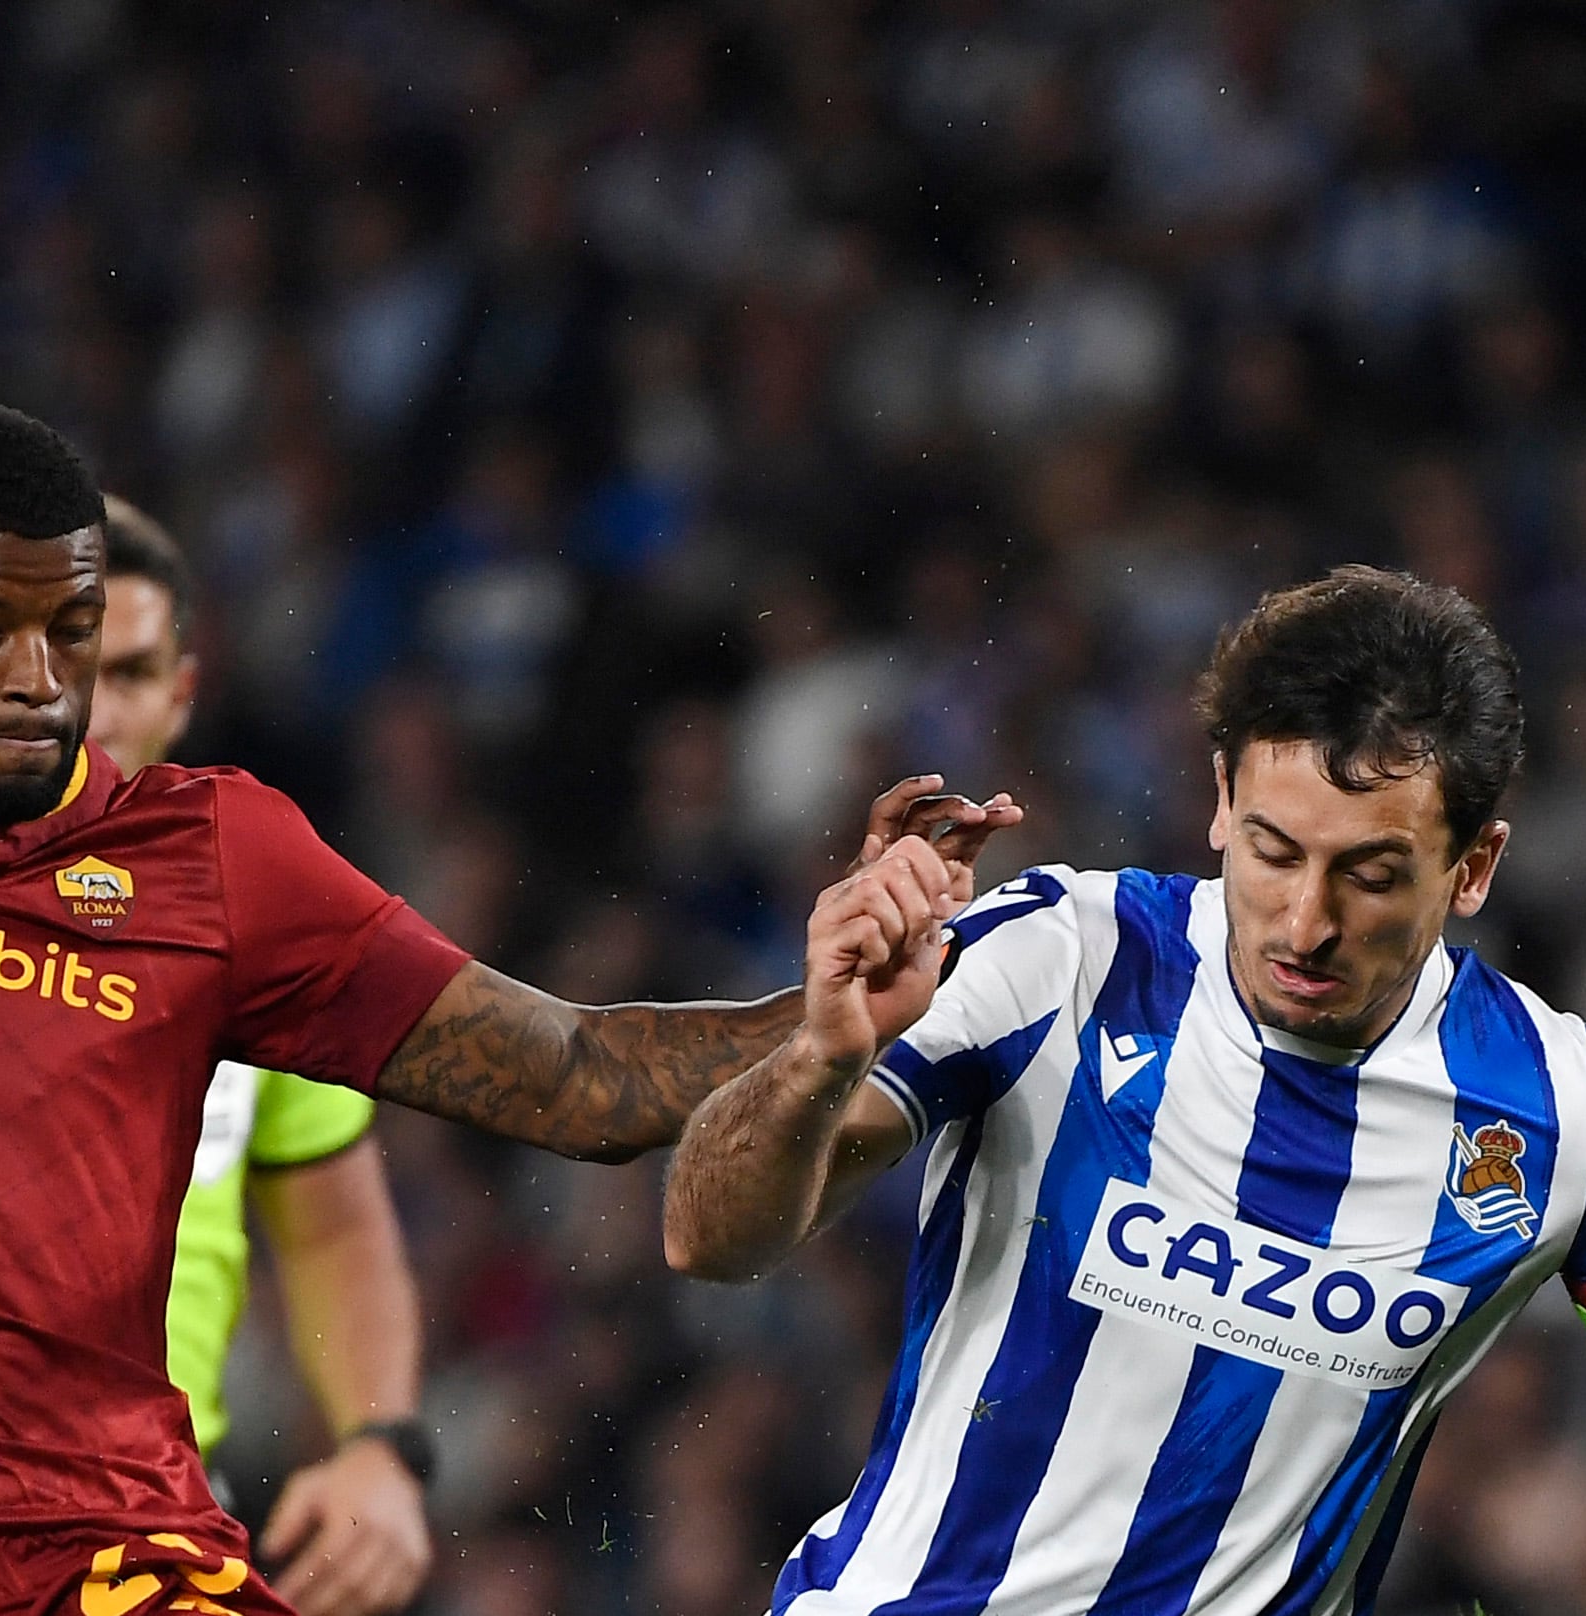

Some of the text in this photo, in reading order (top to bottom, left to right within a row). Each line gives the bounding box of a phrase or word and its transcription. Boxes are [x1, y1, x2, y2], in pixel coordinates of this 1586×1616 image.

[72, 901, 127, 915] ROMA
[91, 918, 113, 927] 1927
[1106, 1202, 1446, 1349] CAZOO
[1080, 1272, 1205, 1332] Encuentra.
[1212, 1319, 1322, 1368] Conduce.
